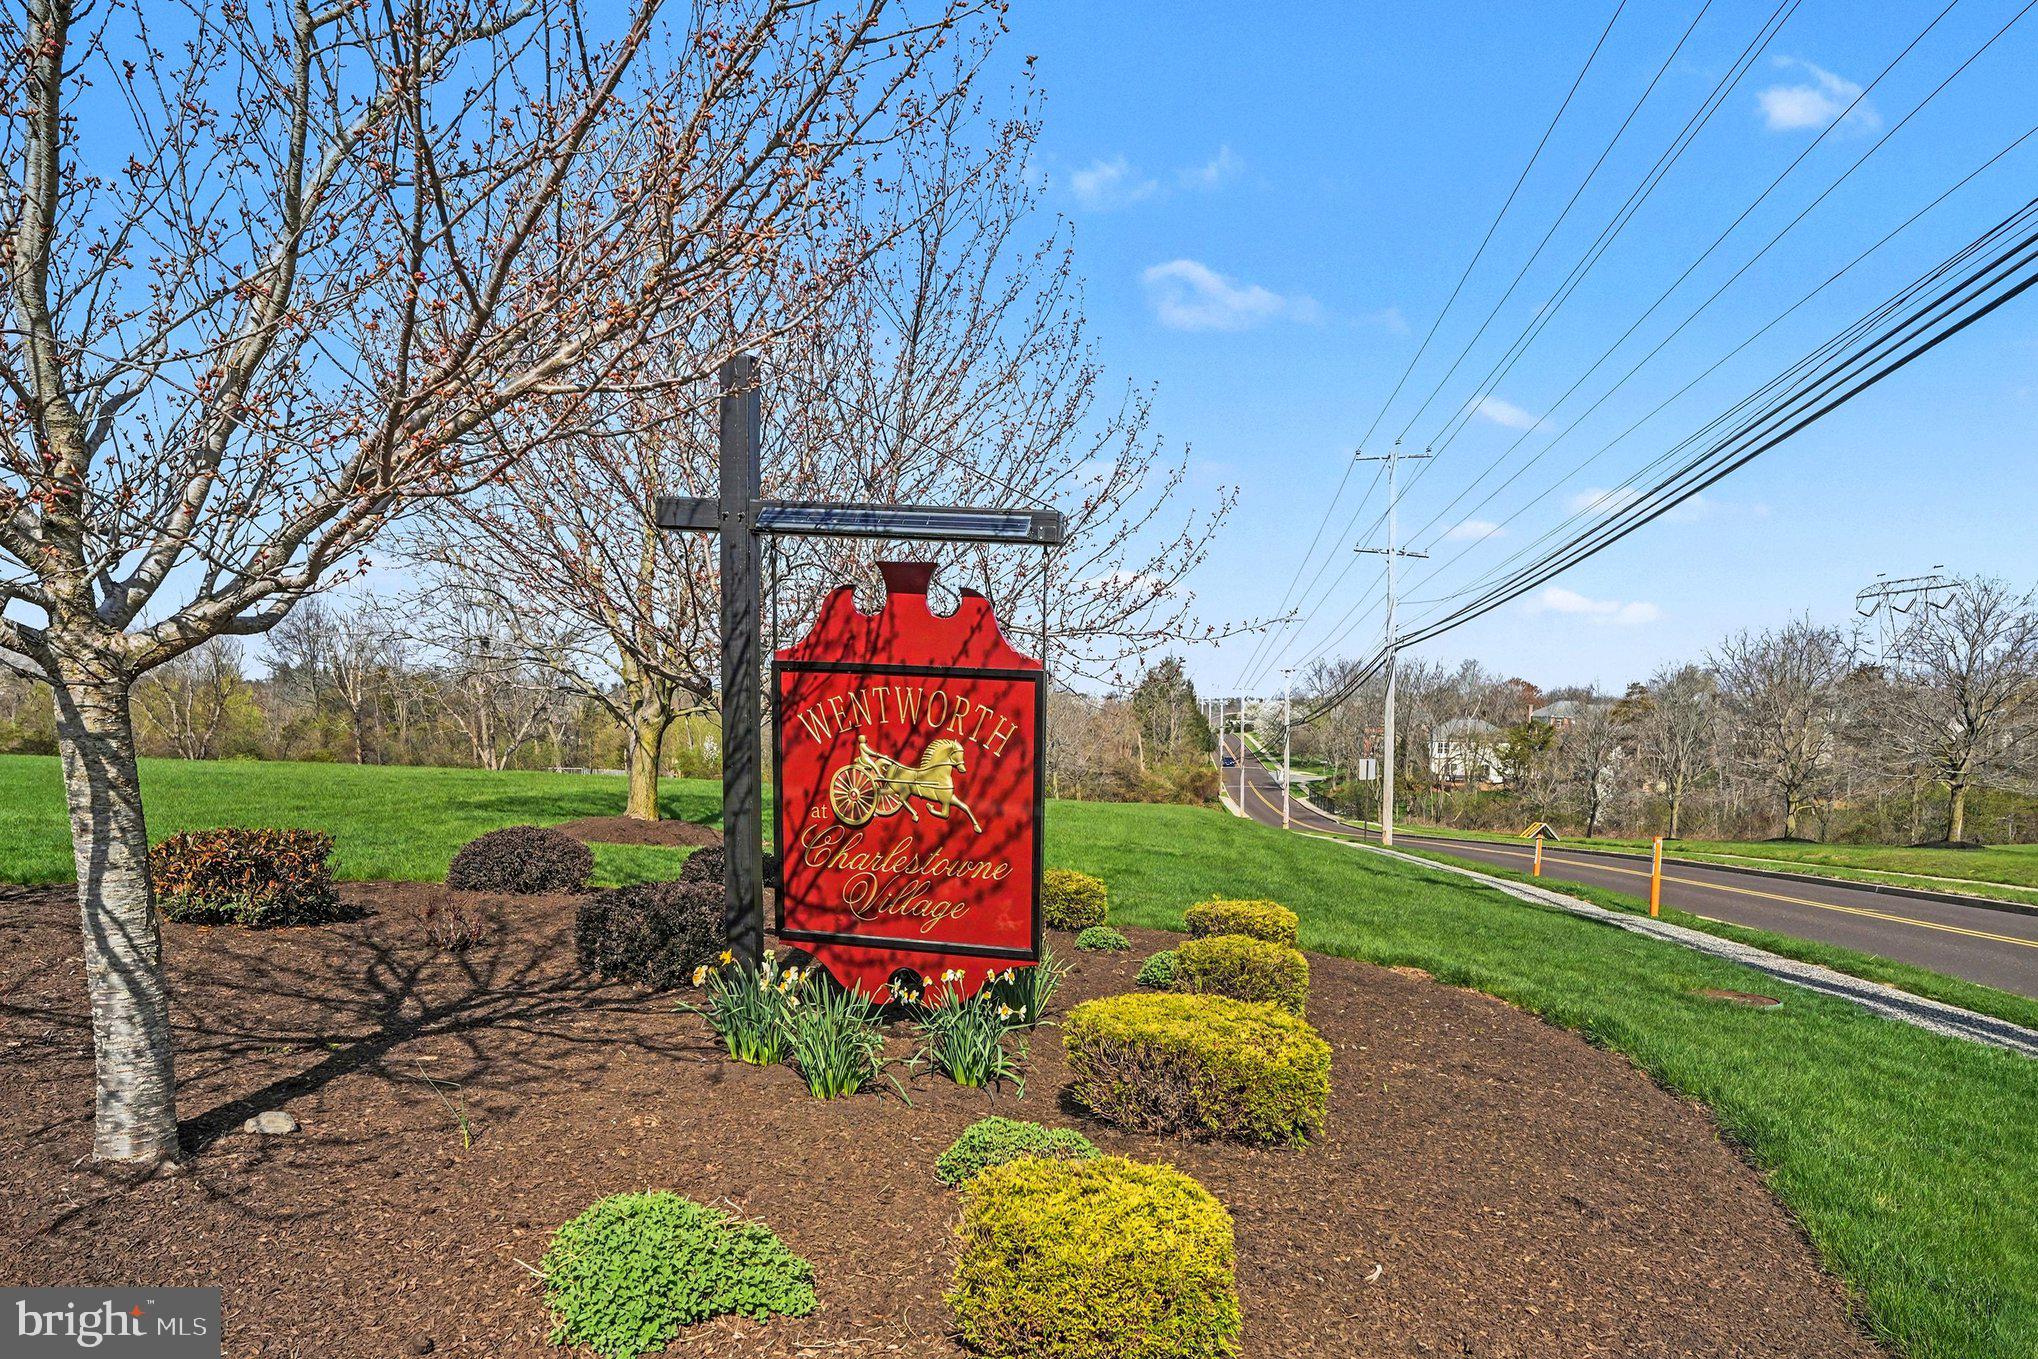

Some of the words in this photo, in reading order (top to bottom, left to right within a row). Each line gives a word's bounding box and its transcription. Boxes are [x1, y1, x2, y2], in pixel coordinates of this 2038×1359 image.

[797, 686, 1018, 758] WENTWORTH
[810, 803, 828, 819] at
[801, 823, 1013, 881] Charlestowne
[842, 871, 970, 934] Village
